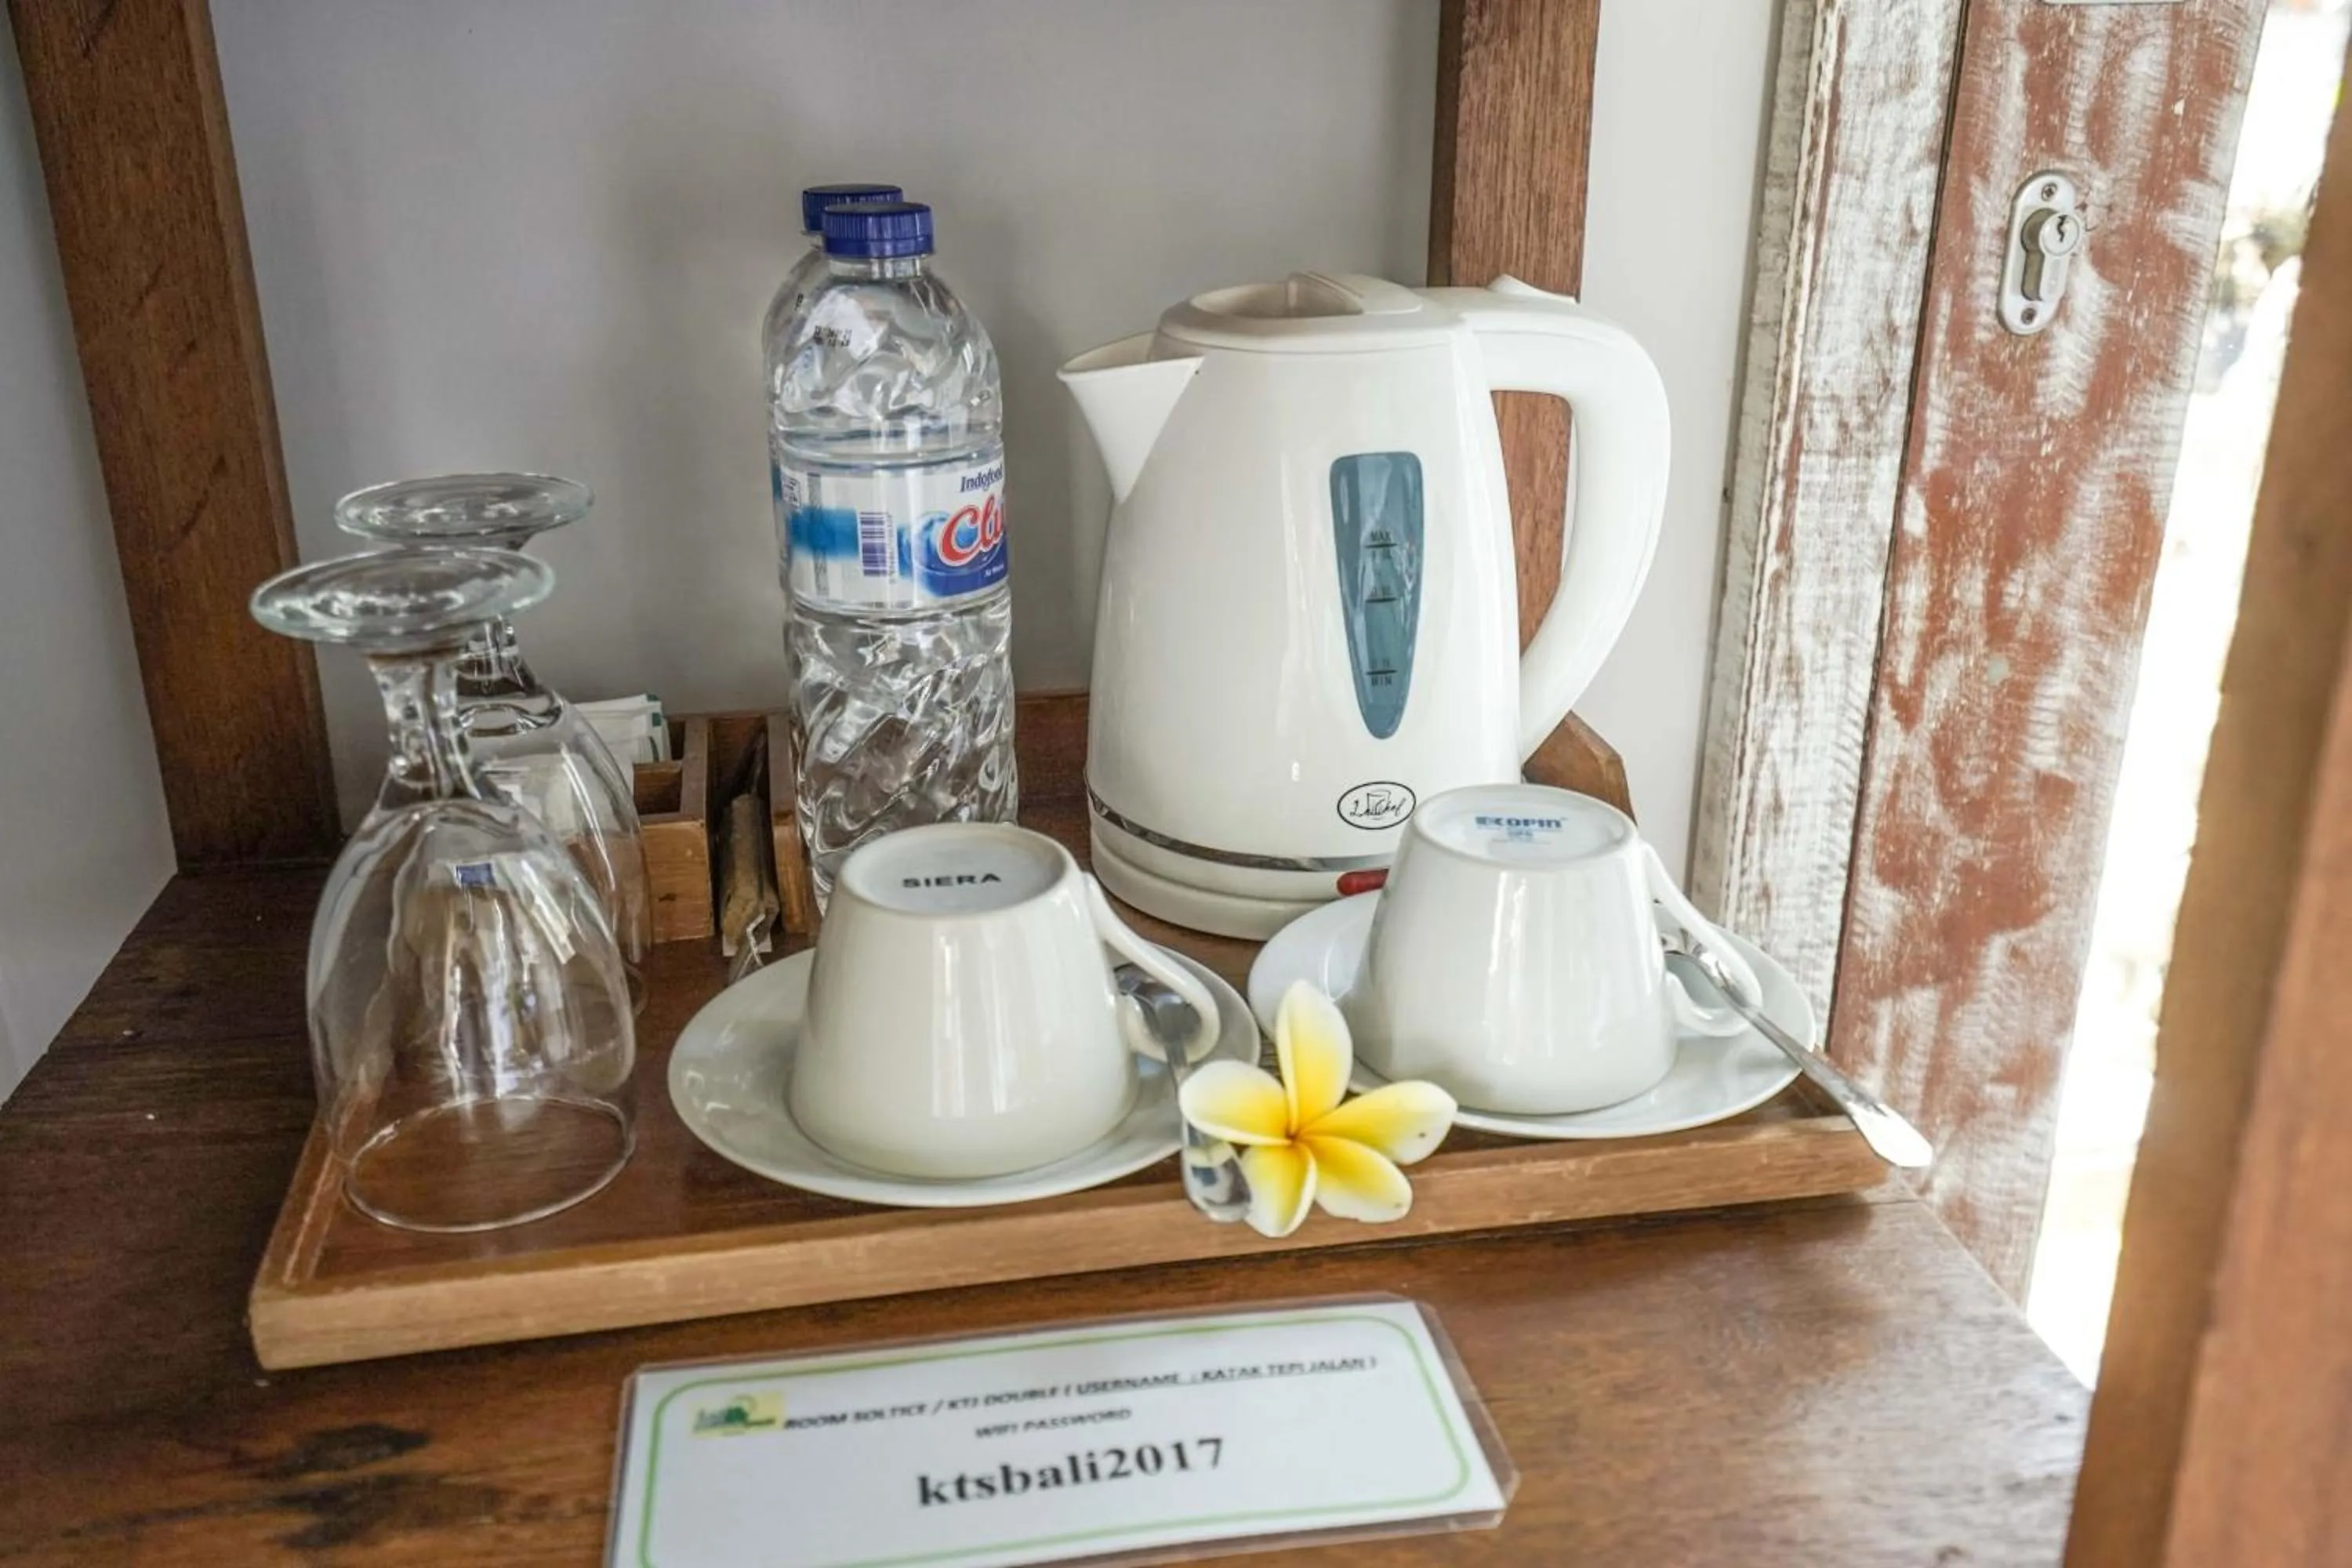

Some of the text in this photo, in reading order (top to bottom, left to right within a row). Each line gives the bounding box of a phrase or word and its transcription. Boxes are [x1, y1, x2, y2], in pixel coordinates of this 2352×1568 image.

[902, 873, 1001, 888] SIERA
[783, 1412, 848, 1429] ROOM
[984, 1387, 1058, 1406] DOUBLE
[1076, 1372, 1179, 1396] USERNAME
[1201, 1366, 1261, 1381] KATAK
[976, 1409, 1133, 1439] WIFI PASSWORD
[917, 1437, 1223, 1507] ktsbali2017
